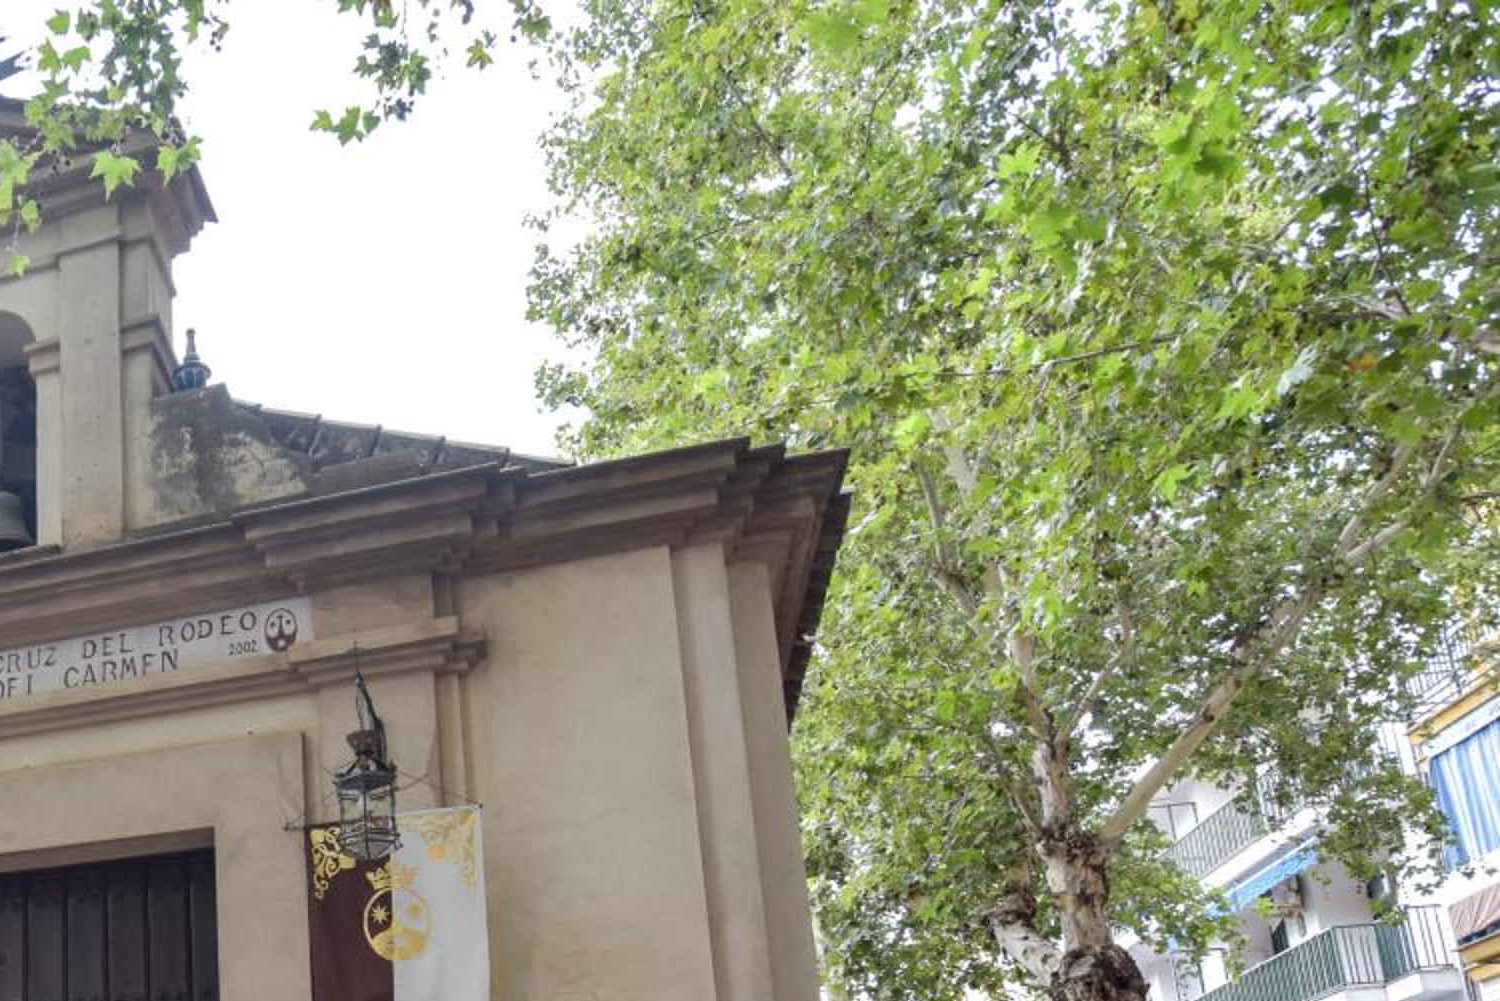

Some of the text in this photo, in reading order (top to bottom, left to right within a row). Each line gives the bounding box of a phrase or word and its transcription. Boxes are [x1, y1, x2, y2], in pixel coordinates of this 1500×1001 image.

[82, 632, 134, 660] DEL
[158, 610, 258, 647] RODEO
[227, 639, 259, 656] 2002
[63, 649, 179, 689] CARMEN
